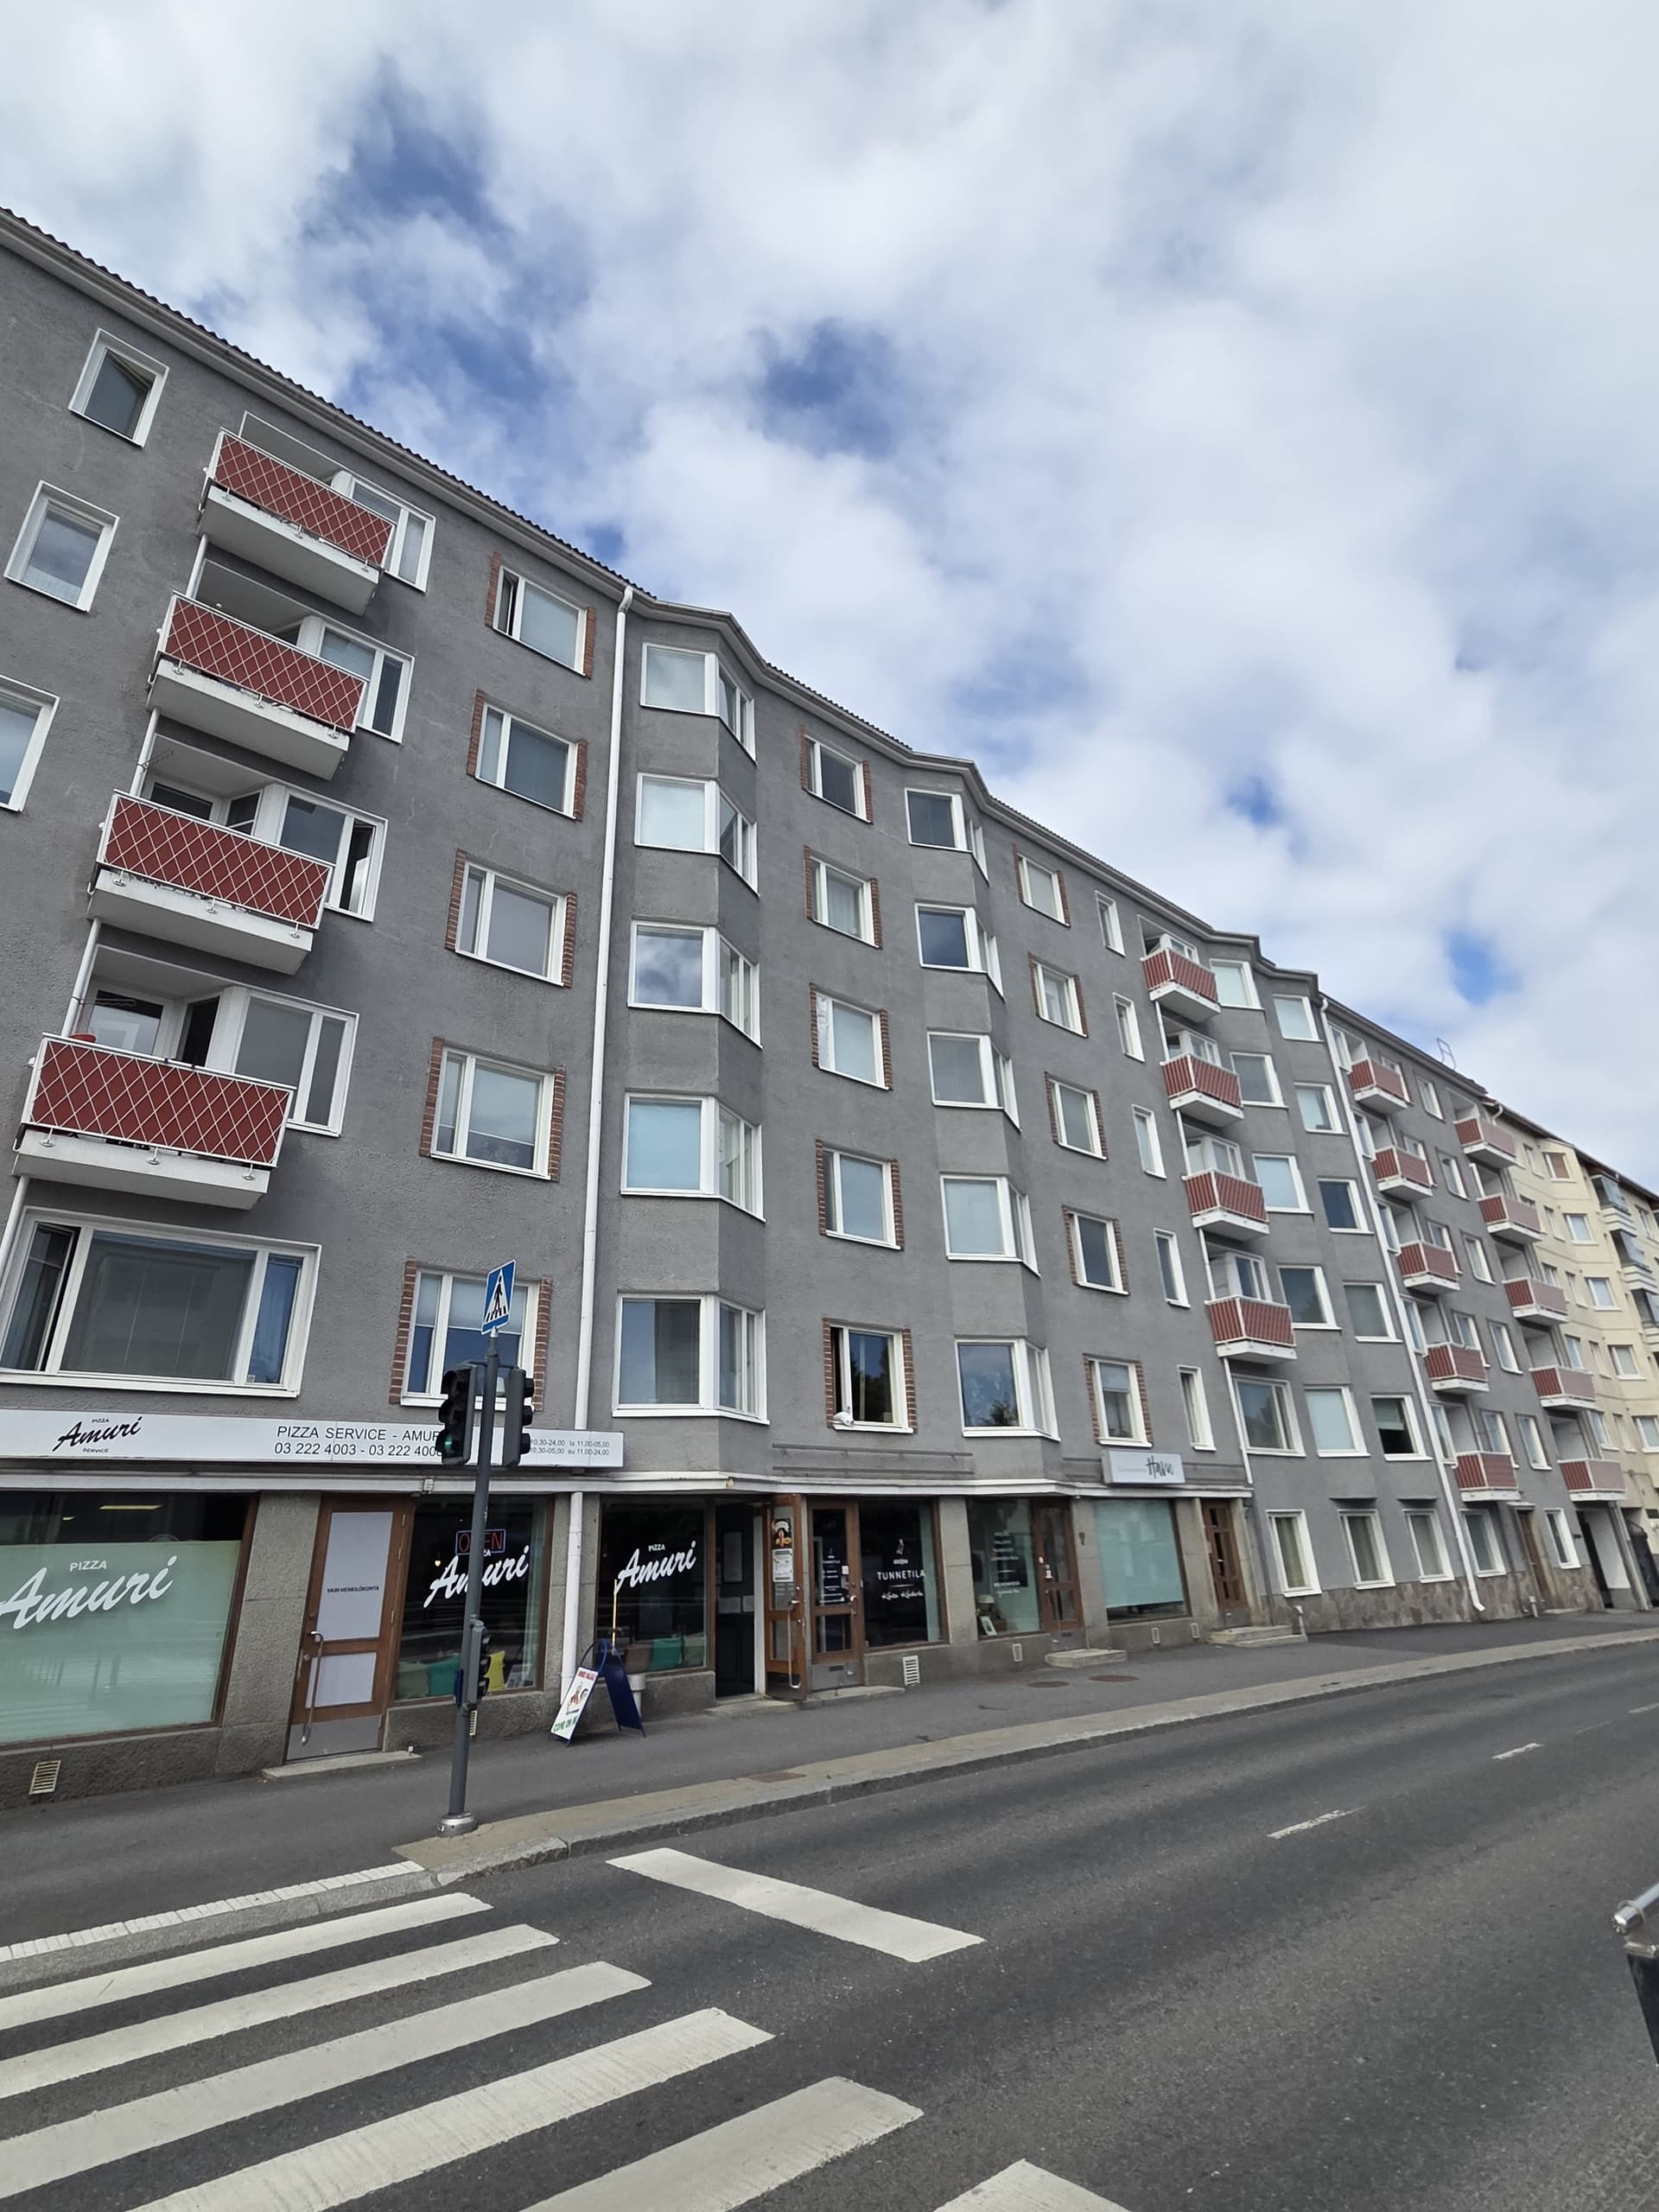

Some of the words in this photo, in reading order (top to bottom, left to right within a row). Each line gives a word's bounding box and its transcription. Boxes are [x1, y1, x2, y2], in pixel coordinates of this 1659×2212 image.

[52, 1416, 143, 1452] Amuri
[276, 1426, 320, 1439] PIZZA
[325, 1427, 386, 1440] SERVICE
[402, 1430, 442, 1441] AMUR
[274, 1443, 291, 1454] 03
[296, 1443, 321, 1455] 222
[324, 1444, 356, 1455] 4003
[368, 1444, 384, 1456] 03
[388, 1445, 410, 1456] 222
[458, 1532, 503, 1553] OEN
[69, 1560, 107, 1572] PIZZA
[613, 1540, 696, 1595] Amuri
[877, 1569, 926, 1580] TUNNETILA
[0, 1555, 178, 1629] Amuri
